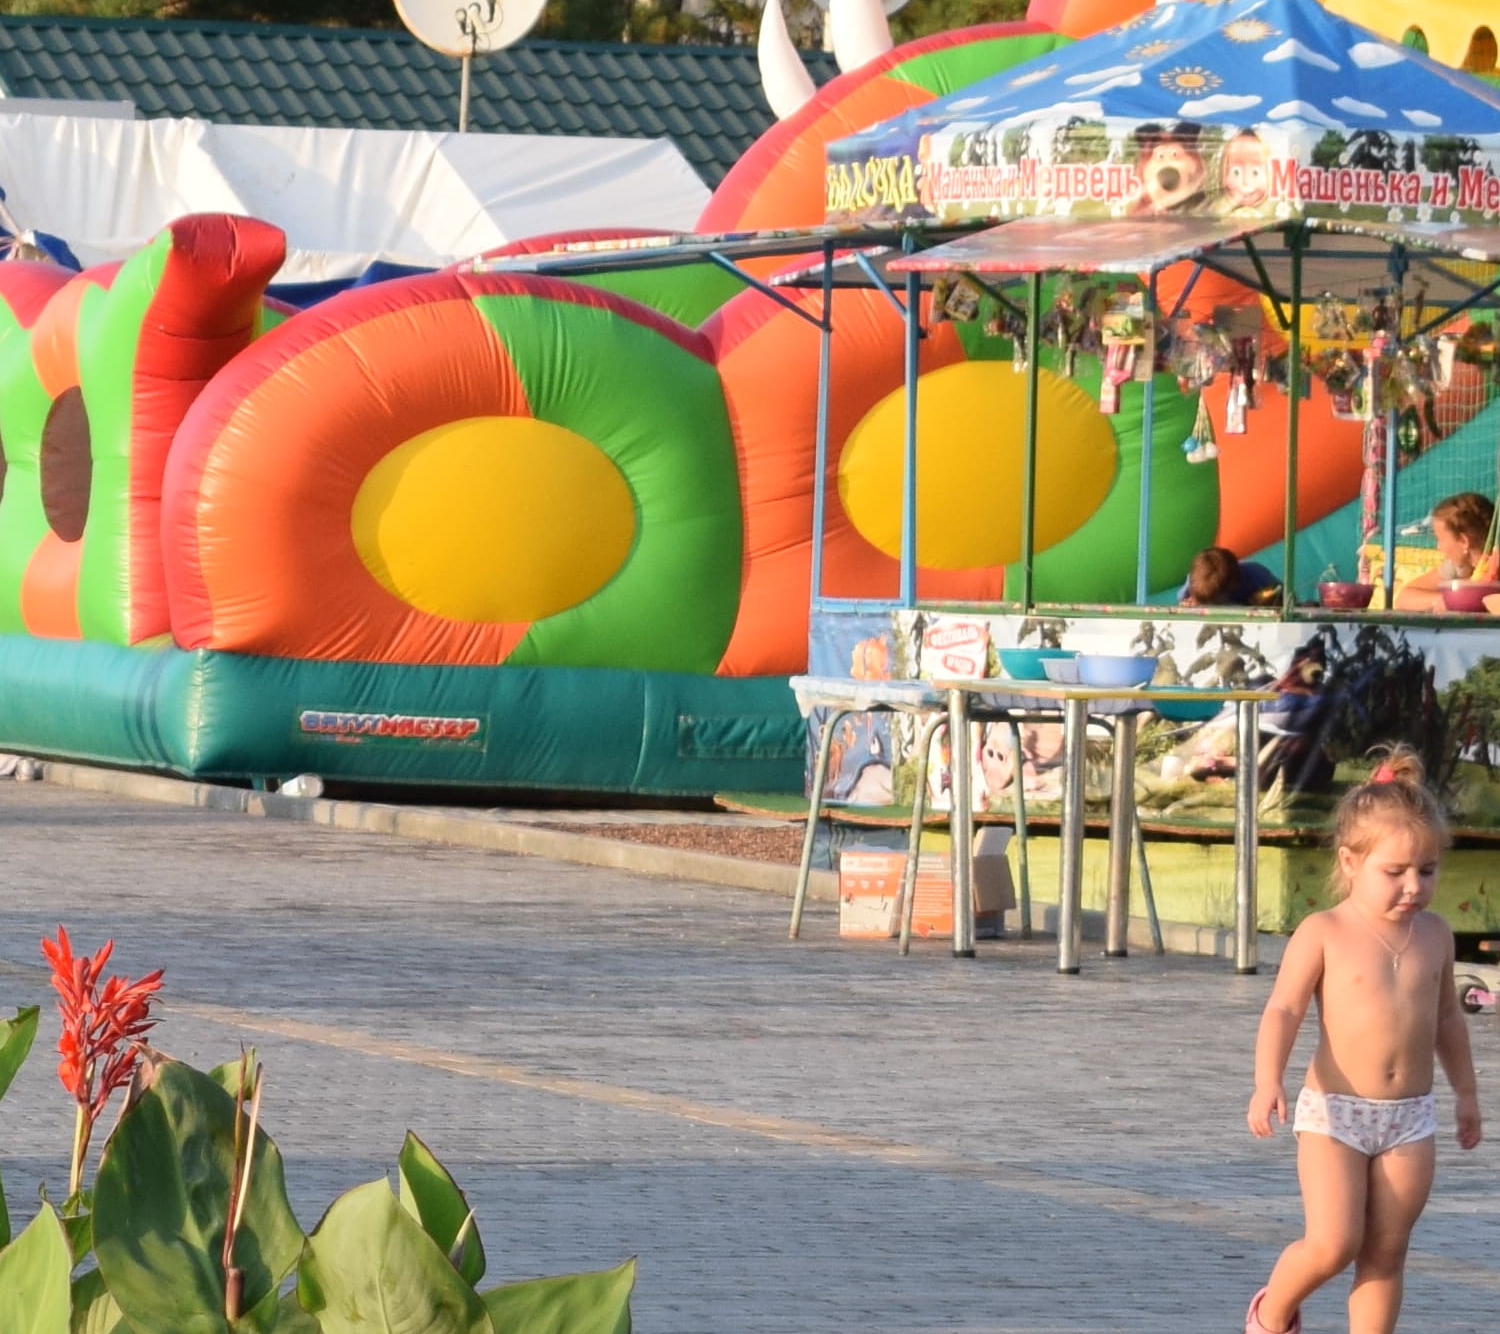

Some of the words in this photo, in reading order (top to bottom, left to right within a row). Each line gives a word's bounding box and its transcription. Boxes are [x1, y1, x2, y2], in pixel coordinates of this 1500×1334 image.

[930, 162, 1002, 200] Машенька
[1020, 157, 1141, 204] Медведь
[1270, 157, 1421, 205] Машенька
[1430, 173, 1450, 205] и
